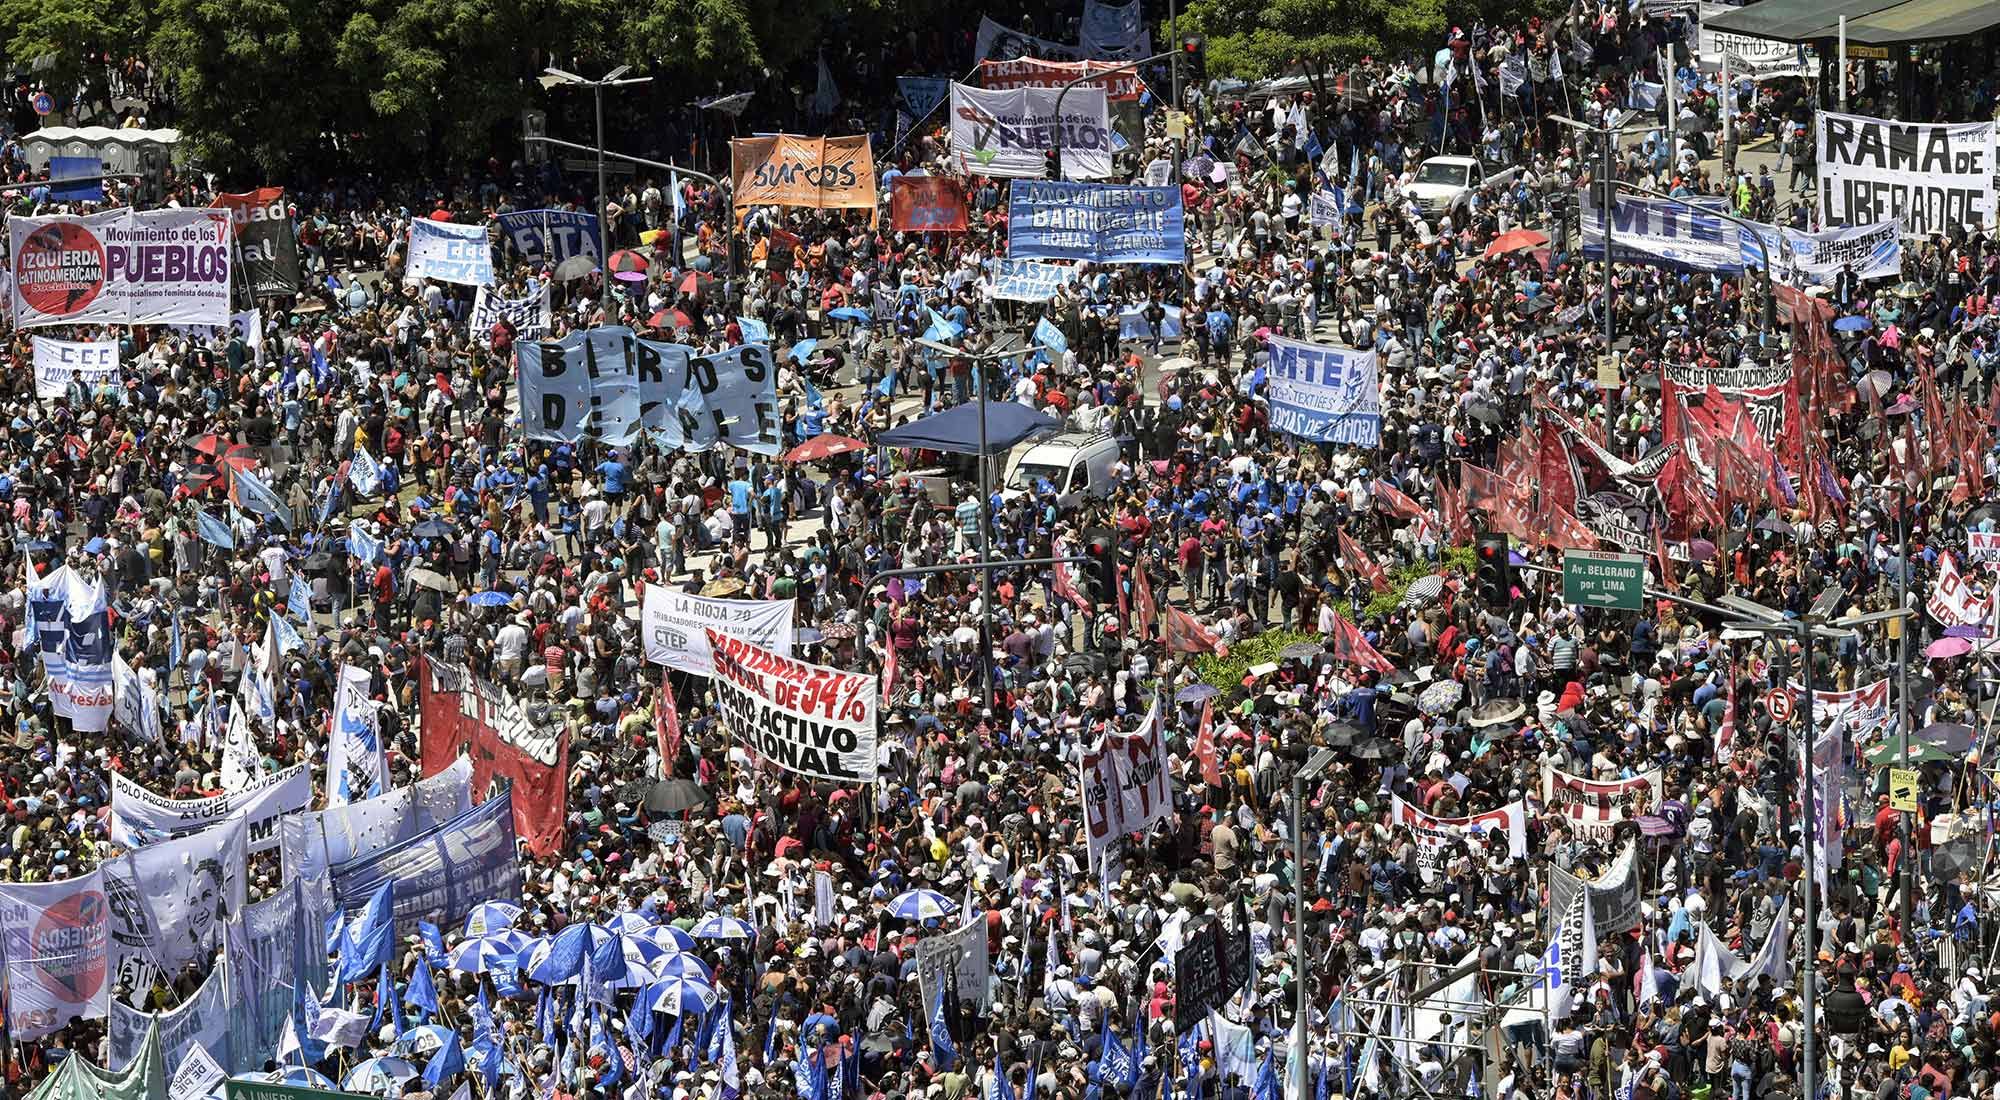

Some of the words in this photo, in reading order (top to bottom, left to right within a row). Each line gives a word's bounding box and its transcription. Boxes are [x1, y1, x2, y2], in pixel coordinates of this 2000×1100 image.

[1713, 33, 1769, 56] BARRIOS
[1066, 113, 1079, 124] de
[999, 124, 1109, 151] PUEBLOS
[1825, 117, 1952, 174] RAMA
[754, 159, 857, 188] surcos
[1955, 151, 1983, 174] DE
[1028, 186, 1167, 208] MOVIMIENTO
[105, 226, 179, 242] Movimiento
[181, 227, 197, 241] de
[199, 227, 216, 241] los
[1040, 231, 1091, 248] LOMAS
[1114, 235, 1166, 250] ZAMORA
[21, 249, 100, 269] IZQUIERDA
[105, 245, 228, 284] PUEBLOS
[998, 259, 1064, 284] BASTA
[105, 288, 118, 297] Por
[164, 287, 196, 298] feminista
[1268, 342, 1345, 388] MTE
[1693, 368, 1704, 386] DE
[1706, 366, 1773, 389] ORGANIZACIONES
[1303, 417, 1324, 437] DE
[1323, 418, 1378, 445] ZAMORA
[1588, 551, 1620, 561] ATENCION
[1571, 564, 1586, 576] Av.
[1587, 564, 1637, 579] BELGRANO
[1580, 581, 1595, 591] por
[1602, 581, 1626, 592] LIMA
[675, 598, 689, 613] LA
[693, 601, 728, 620] RIOJA
[655, 629, 688, 648] CTEP
[706, 628, 808, 684] PARITARIA
[800, 668, 869, 723] 54%
[713, 649, 771, 700] SOCIAL
[775, 680, 800, 712] DE
[719, 679, 756, 723] PARO
[759, 704, 859, 754] ACTIVO
[725, 707, 860, 779] NACIONAL
[115, 779, 142, 800] POLO
[142, 791, 213, 810] PRODUCTIVO
[1553, 787, 1598, 807] ANIBAL
